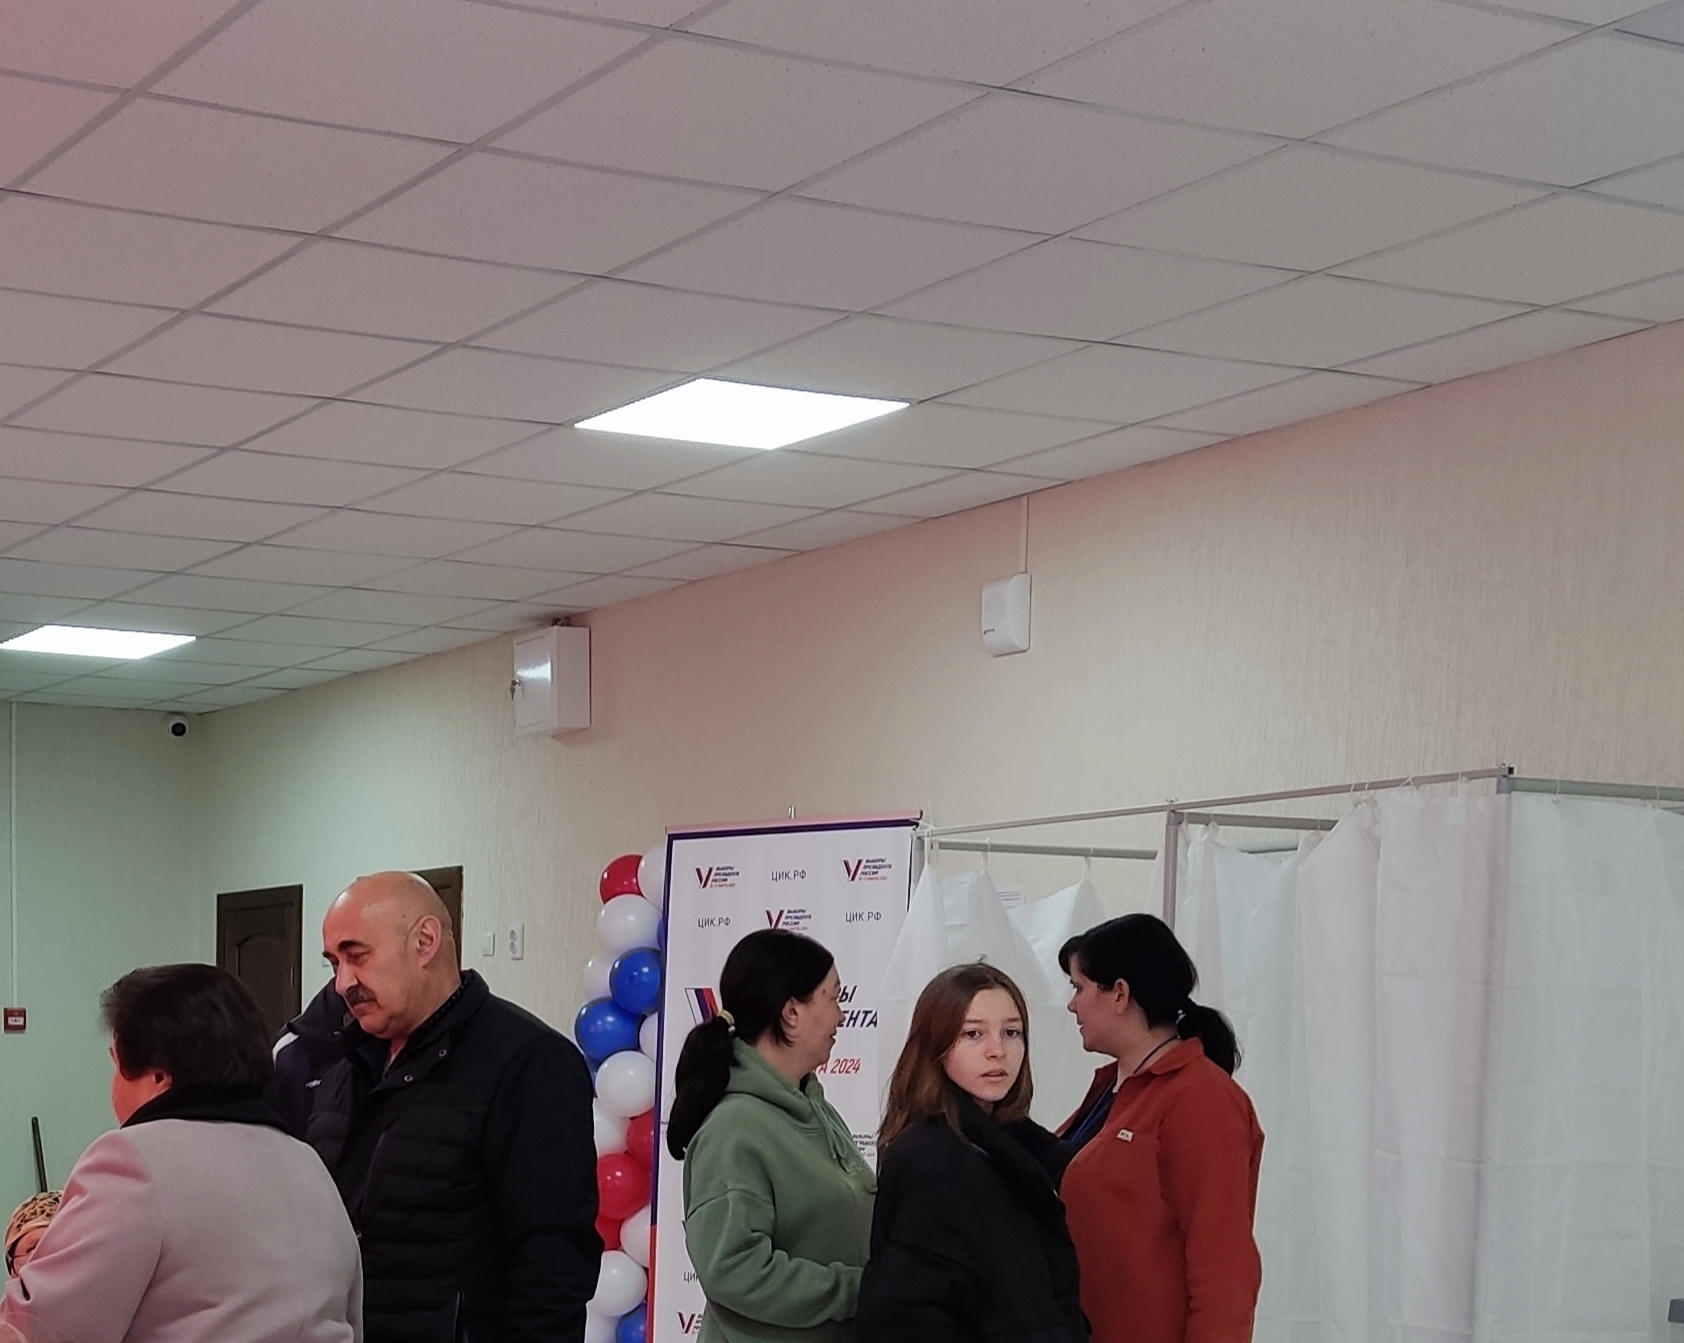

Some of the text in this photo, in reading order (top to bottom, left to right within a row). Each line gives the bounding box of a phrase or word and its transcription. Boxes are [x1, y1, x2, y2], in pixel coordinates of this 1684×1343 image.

[771, 870, 807, 881] ЦИК.РФ
[698, 917, 731, 928] ЦИК.РФ
[845, 912, 882, 923] ЦИК.РФ
[830, 1059, 861, 1073] 2024
